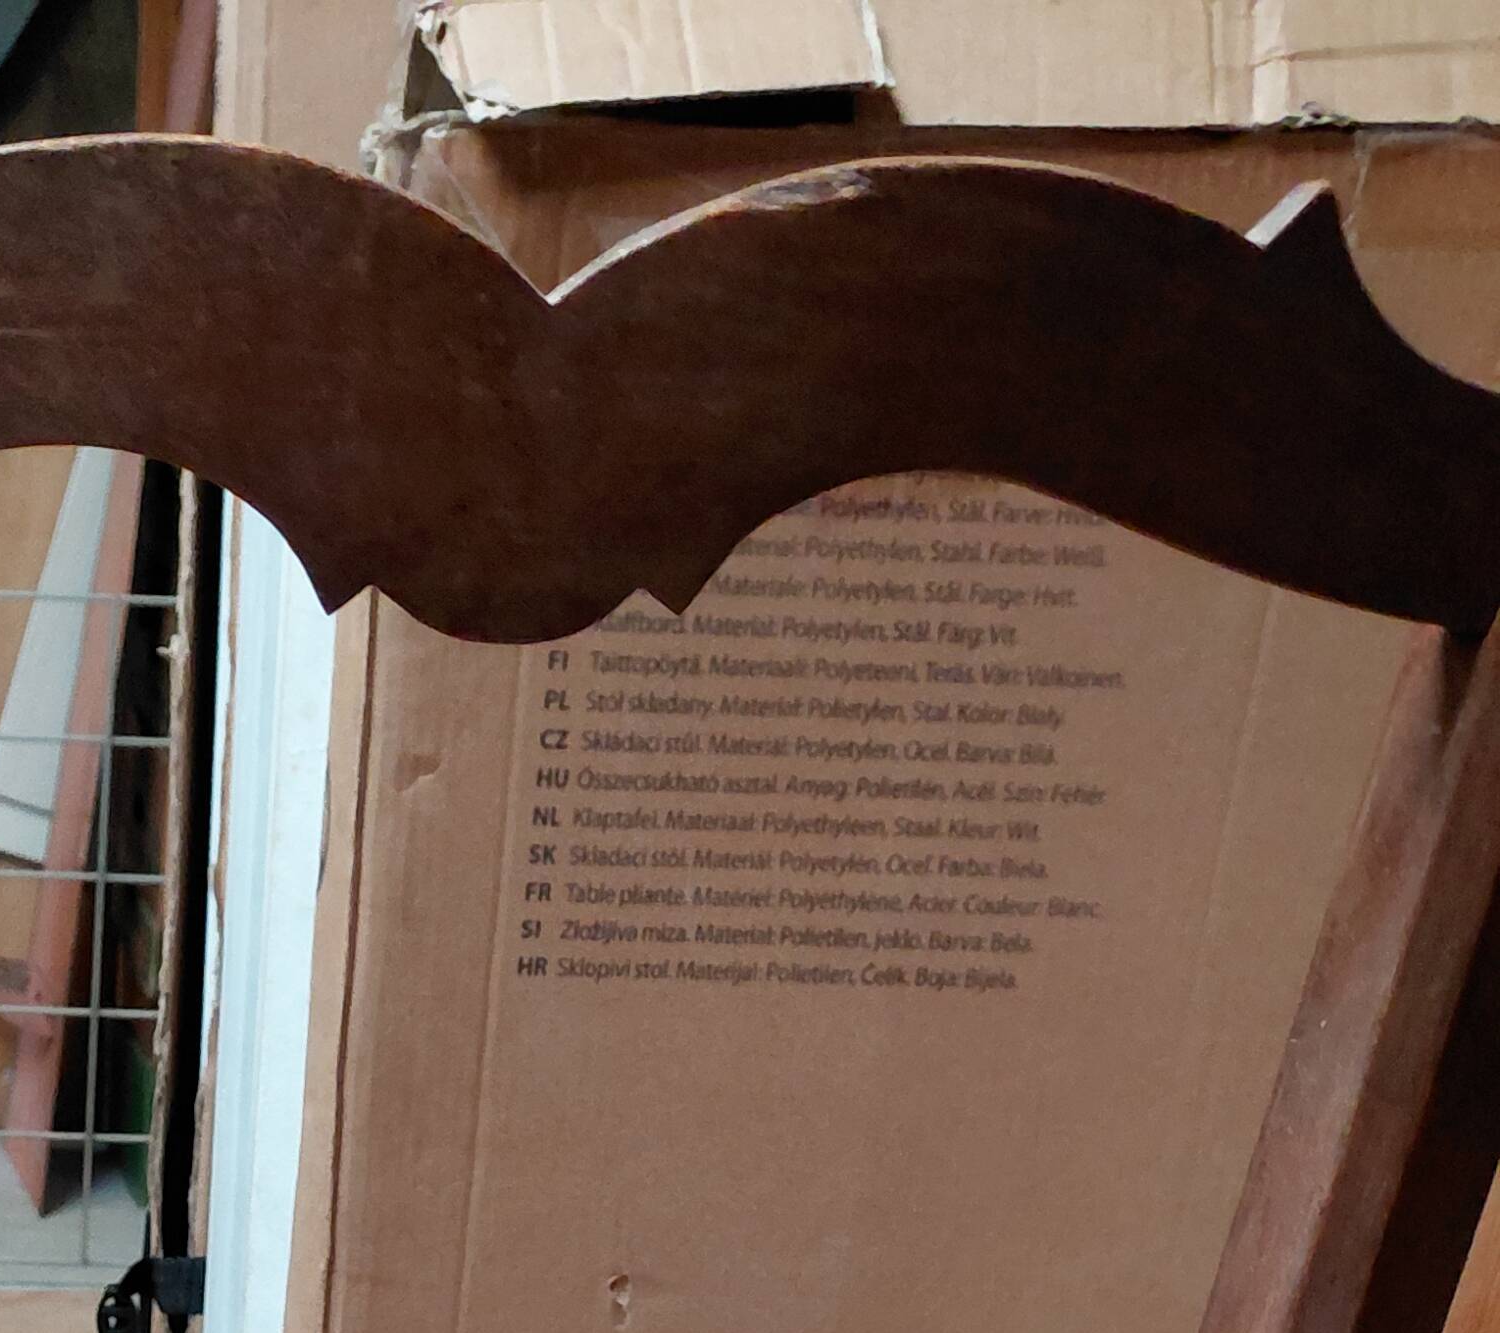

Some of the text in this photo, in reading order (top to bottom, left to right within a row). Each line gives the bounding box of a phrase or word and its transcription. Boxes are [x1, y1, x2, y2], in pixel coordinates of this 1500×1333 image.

[548, 650, 569, 671] FI
[543, 689, 570, 712] PL
[539, 728, 570, 751] CZ
[536, 767, 570, 789] HU
[533, 806, 560, 828] NL
[529, 844, 557, 865] SK
[524, 882, 552, 903] FR
[520, 919, 542, 940] SI
[517, 956, 548, 977] HR
